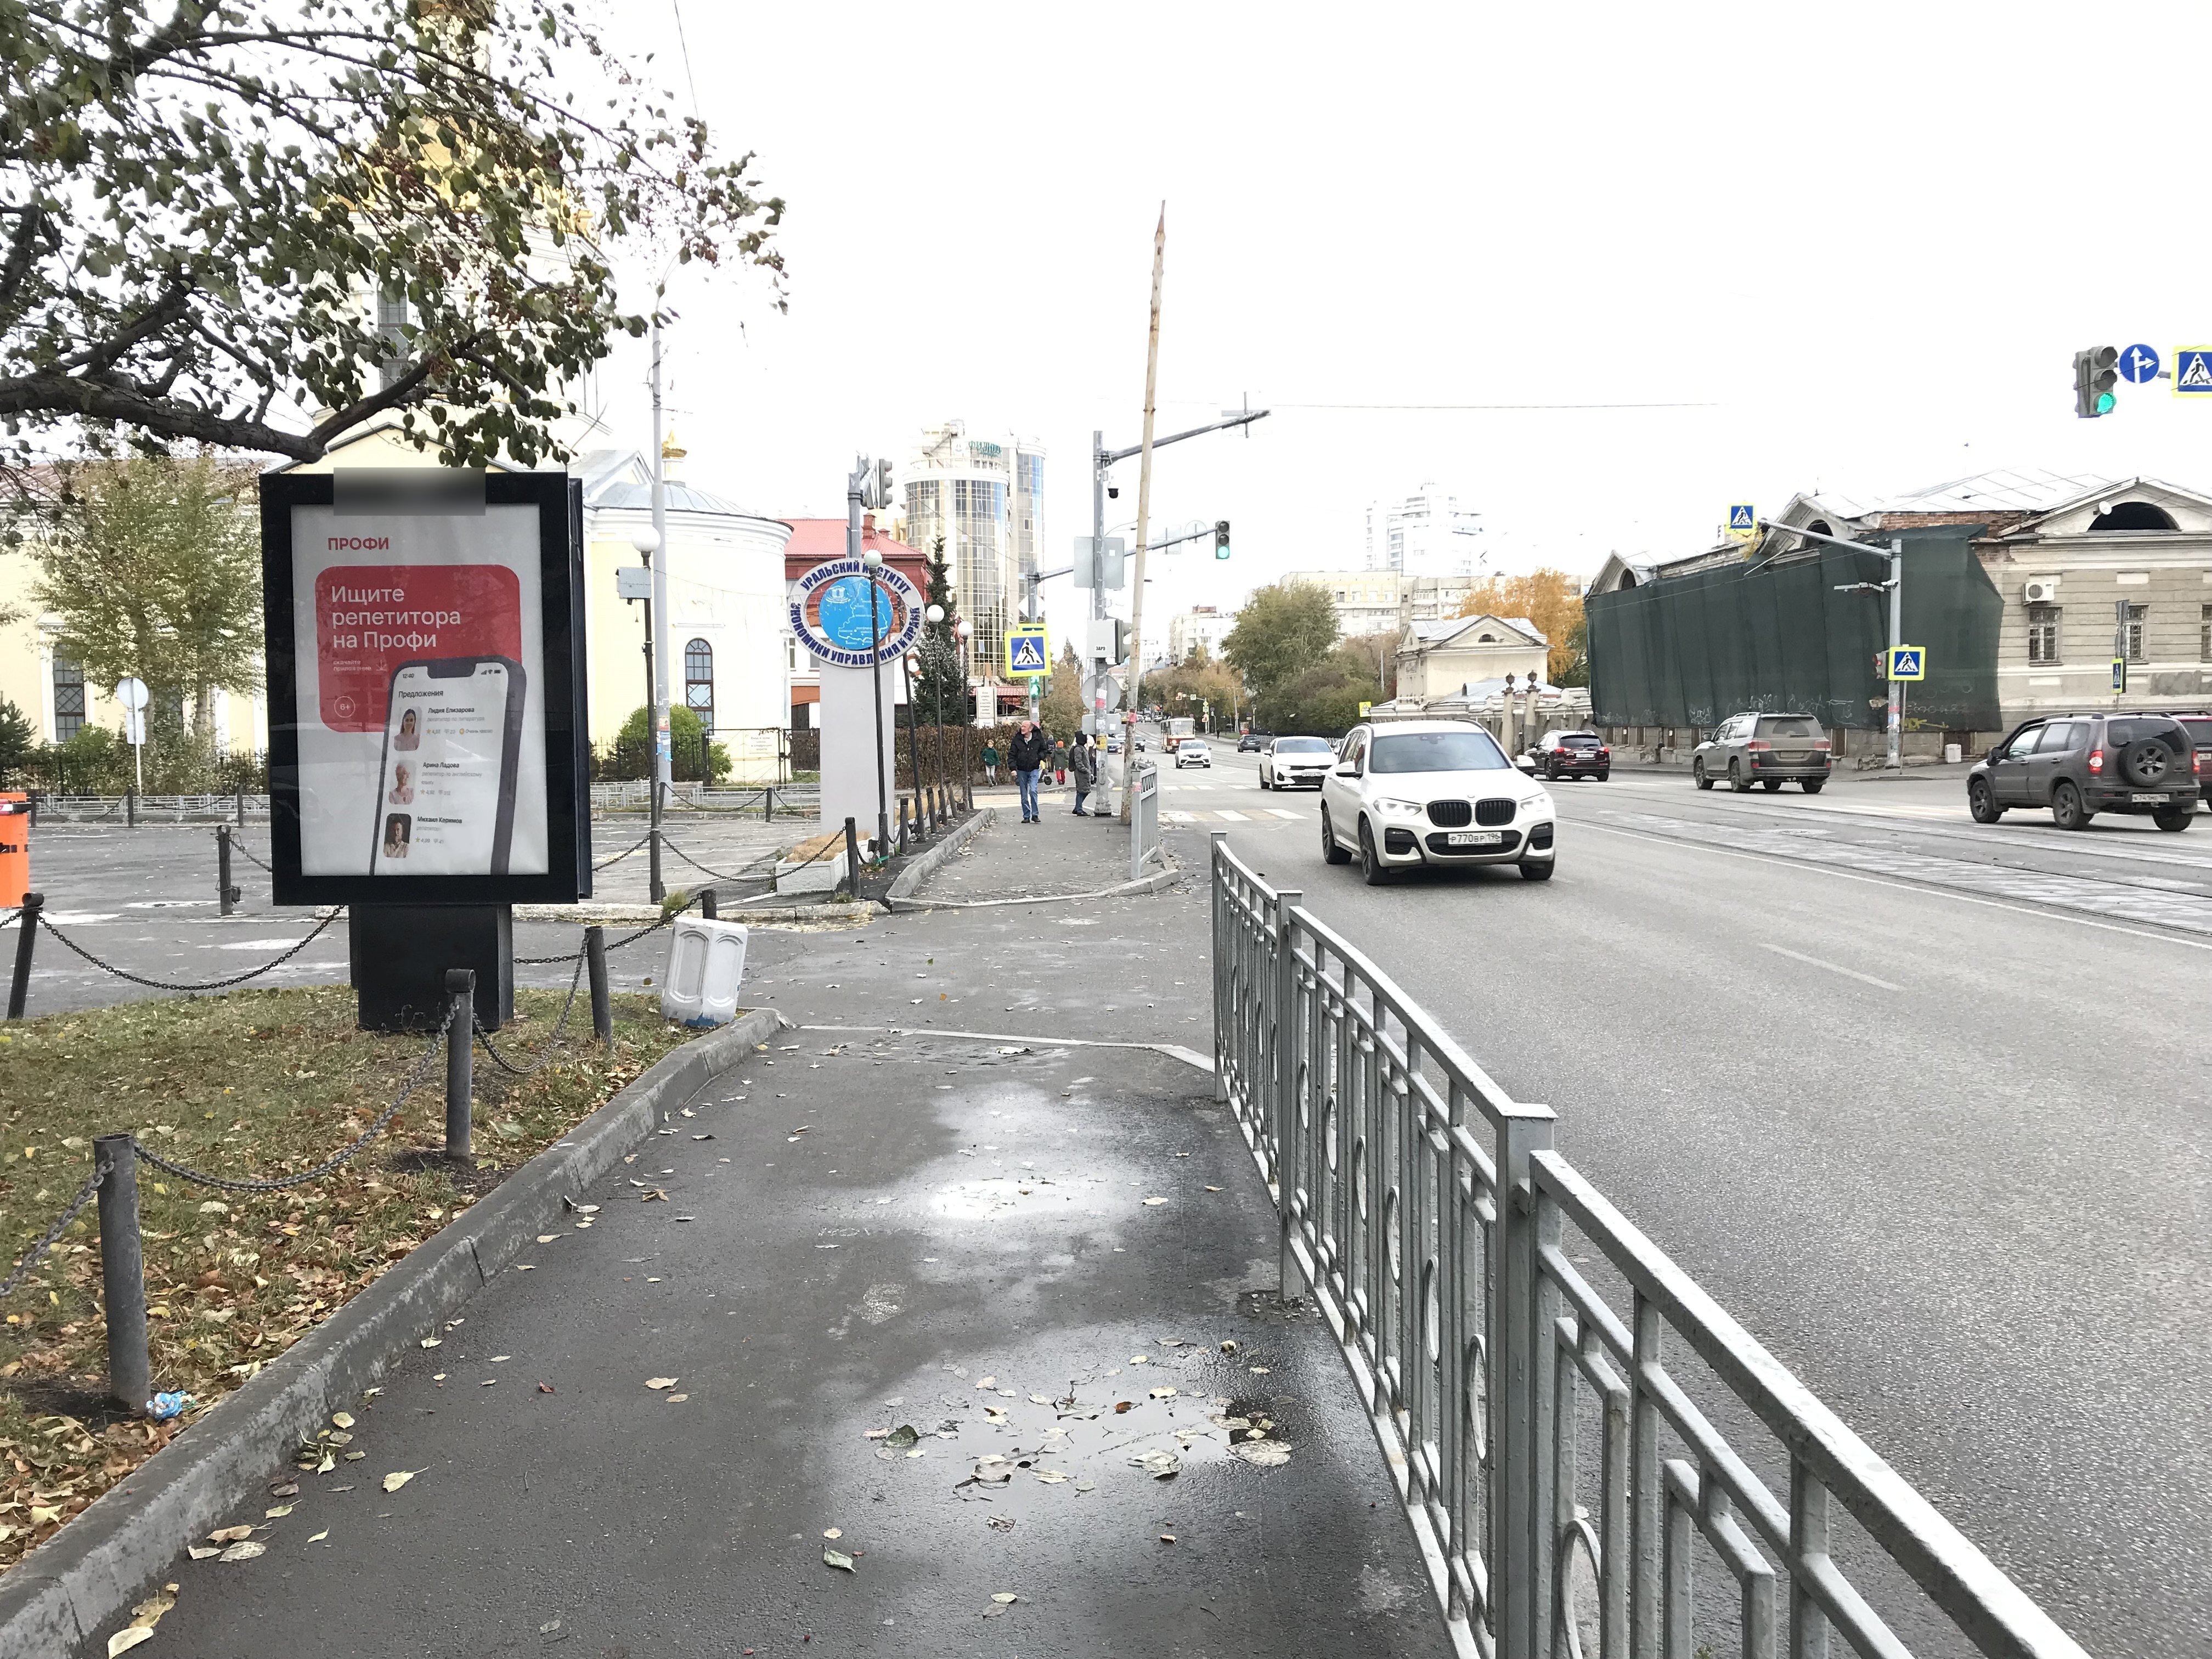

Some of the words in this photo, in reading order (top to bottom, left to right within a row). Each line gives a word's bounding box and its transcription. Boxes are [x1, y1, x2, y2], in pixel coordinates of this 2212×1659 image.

[328, 537, 390, 550] ПРОФИ
[800, 560, 860, 591] УРАЛЬСКИЙ
[862, 562, 911, 594] ИСТИТУТ
[331, 586, 405, 606] Ищите
[332, 610, 461, 629] репетитора
[334, 635, 358, 649] на
[364, 630, 437, 652] Профи
[791, 602, 831, 658] ЭКОНОМИКИ
[830, 643, 901, 665] УПРАВЛНИЯ
[898, 637, 909, 648] И
[398, 690, 444, 698] Предложения
[1451, 834, 1485, 843] Р770ВР
